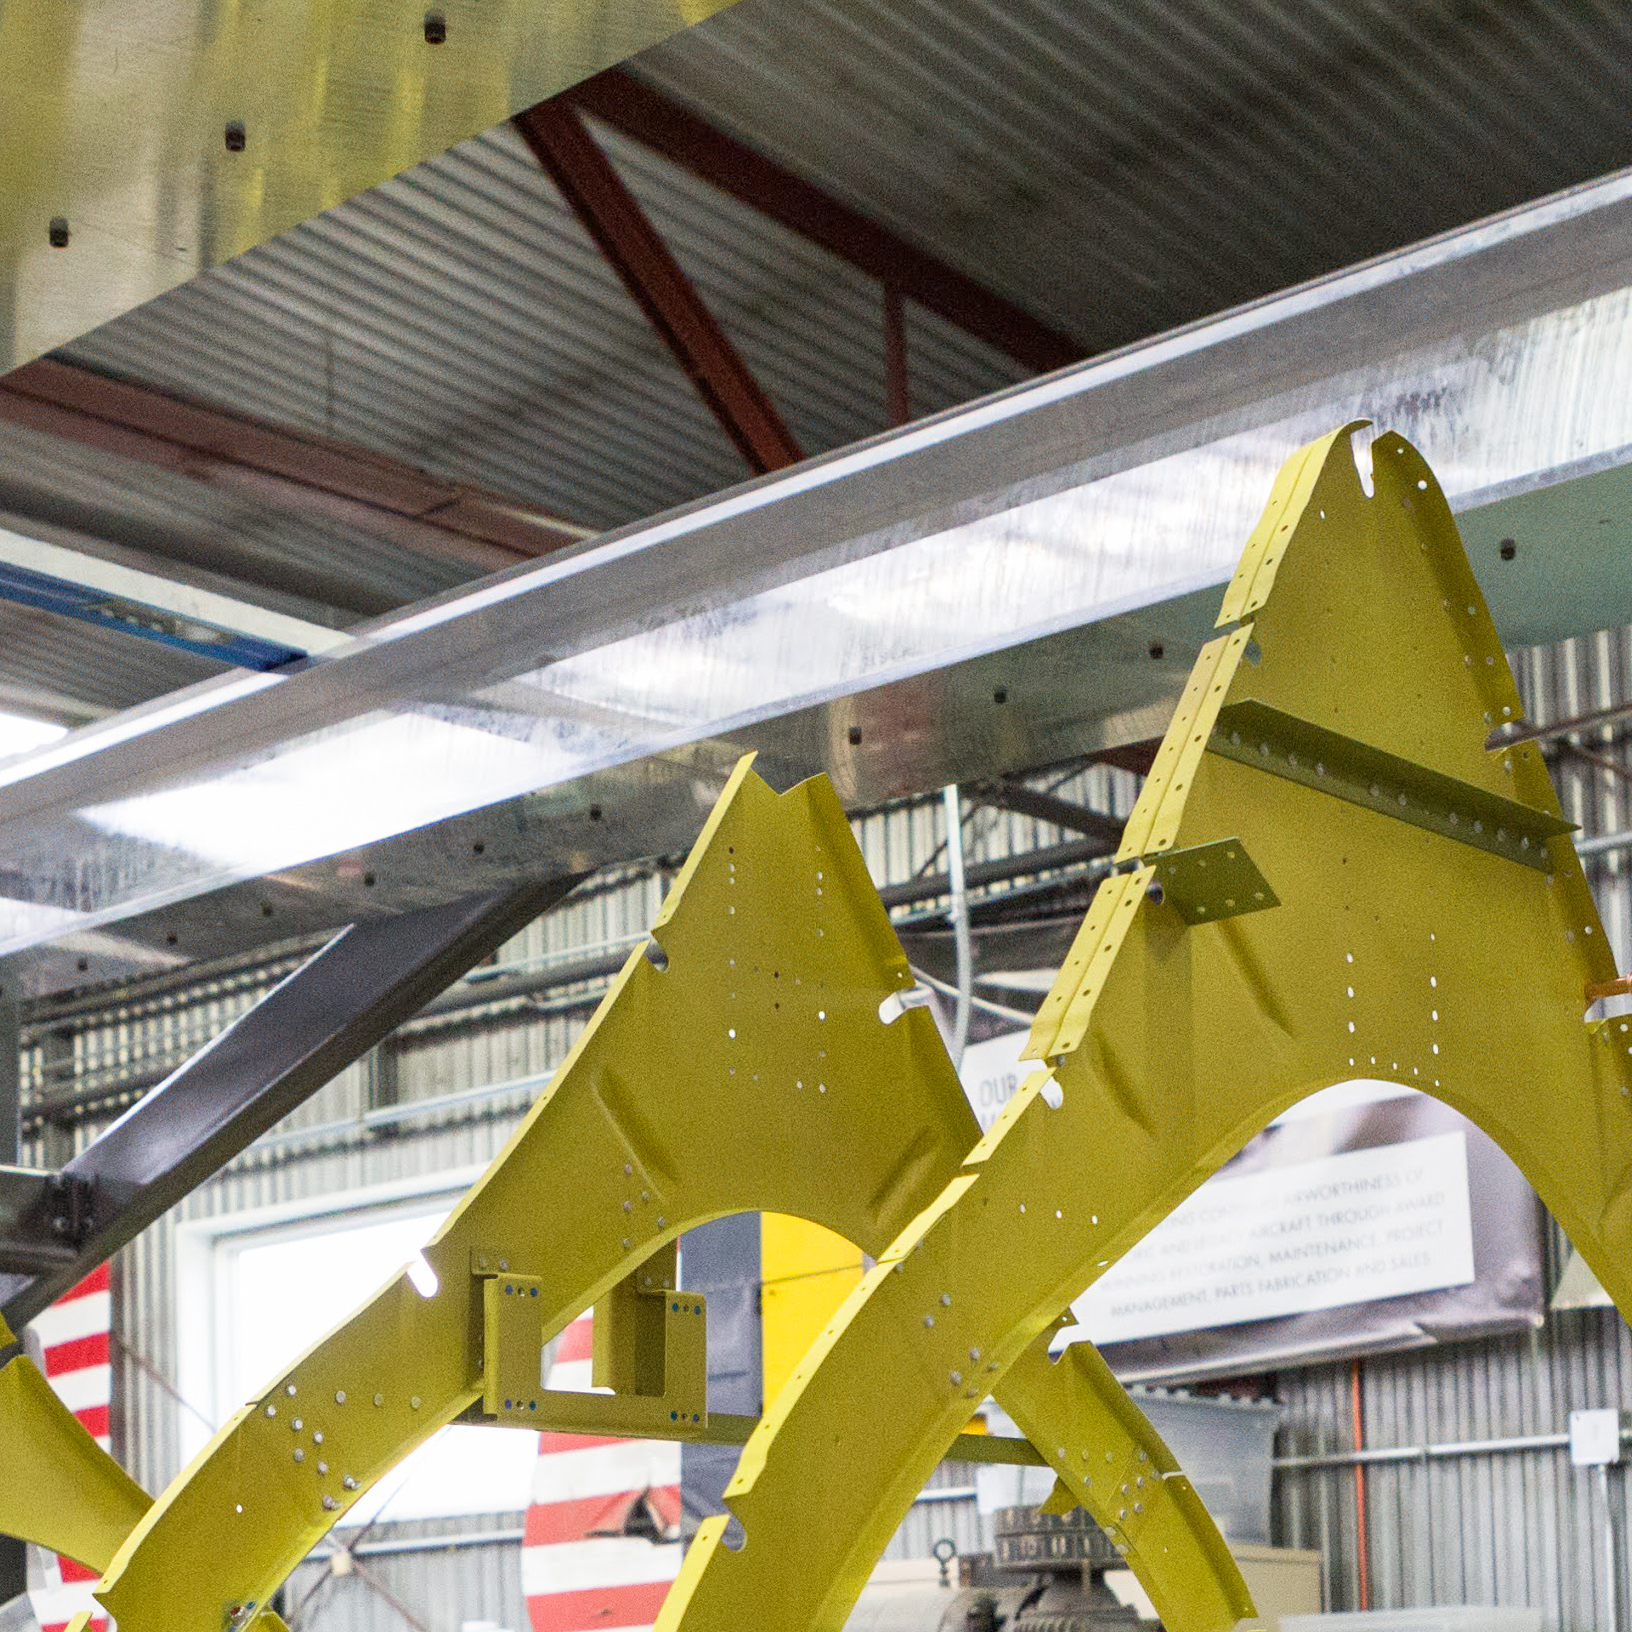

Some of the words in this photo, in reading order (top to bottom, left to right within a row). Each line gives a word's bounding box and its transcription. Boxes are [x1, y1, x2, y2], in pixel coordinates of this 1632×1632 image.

[1284, 1173, 1401, 1206] AIRWORTHINESS
[1249, 1215, 1311, 1241] AIRCRAFT
[1316, 1203, 1391, 1229] THROUGH
[1396, 1190, 1446, 1213] AWARD
[1387, 1218, 1444, 1244] PROJECT
[1215, 1279, 1255, 1302] PARTS
[1258, 1263, 1350, 1295] FABRICATION
[1391, 1250, 1432, 1272] SALES
